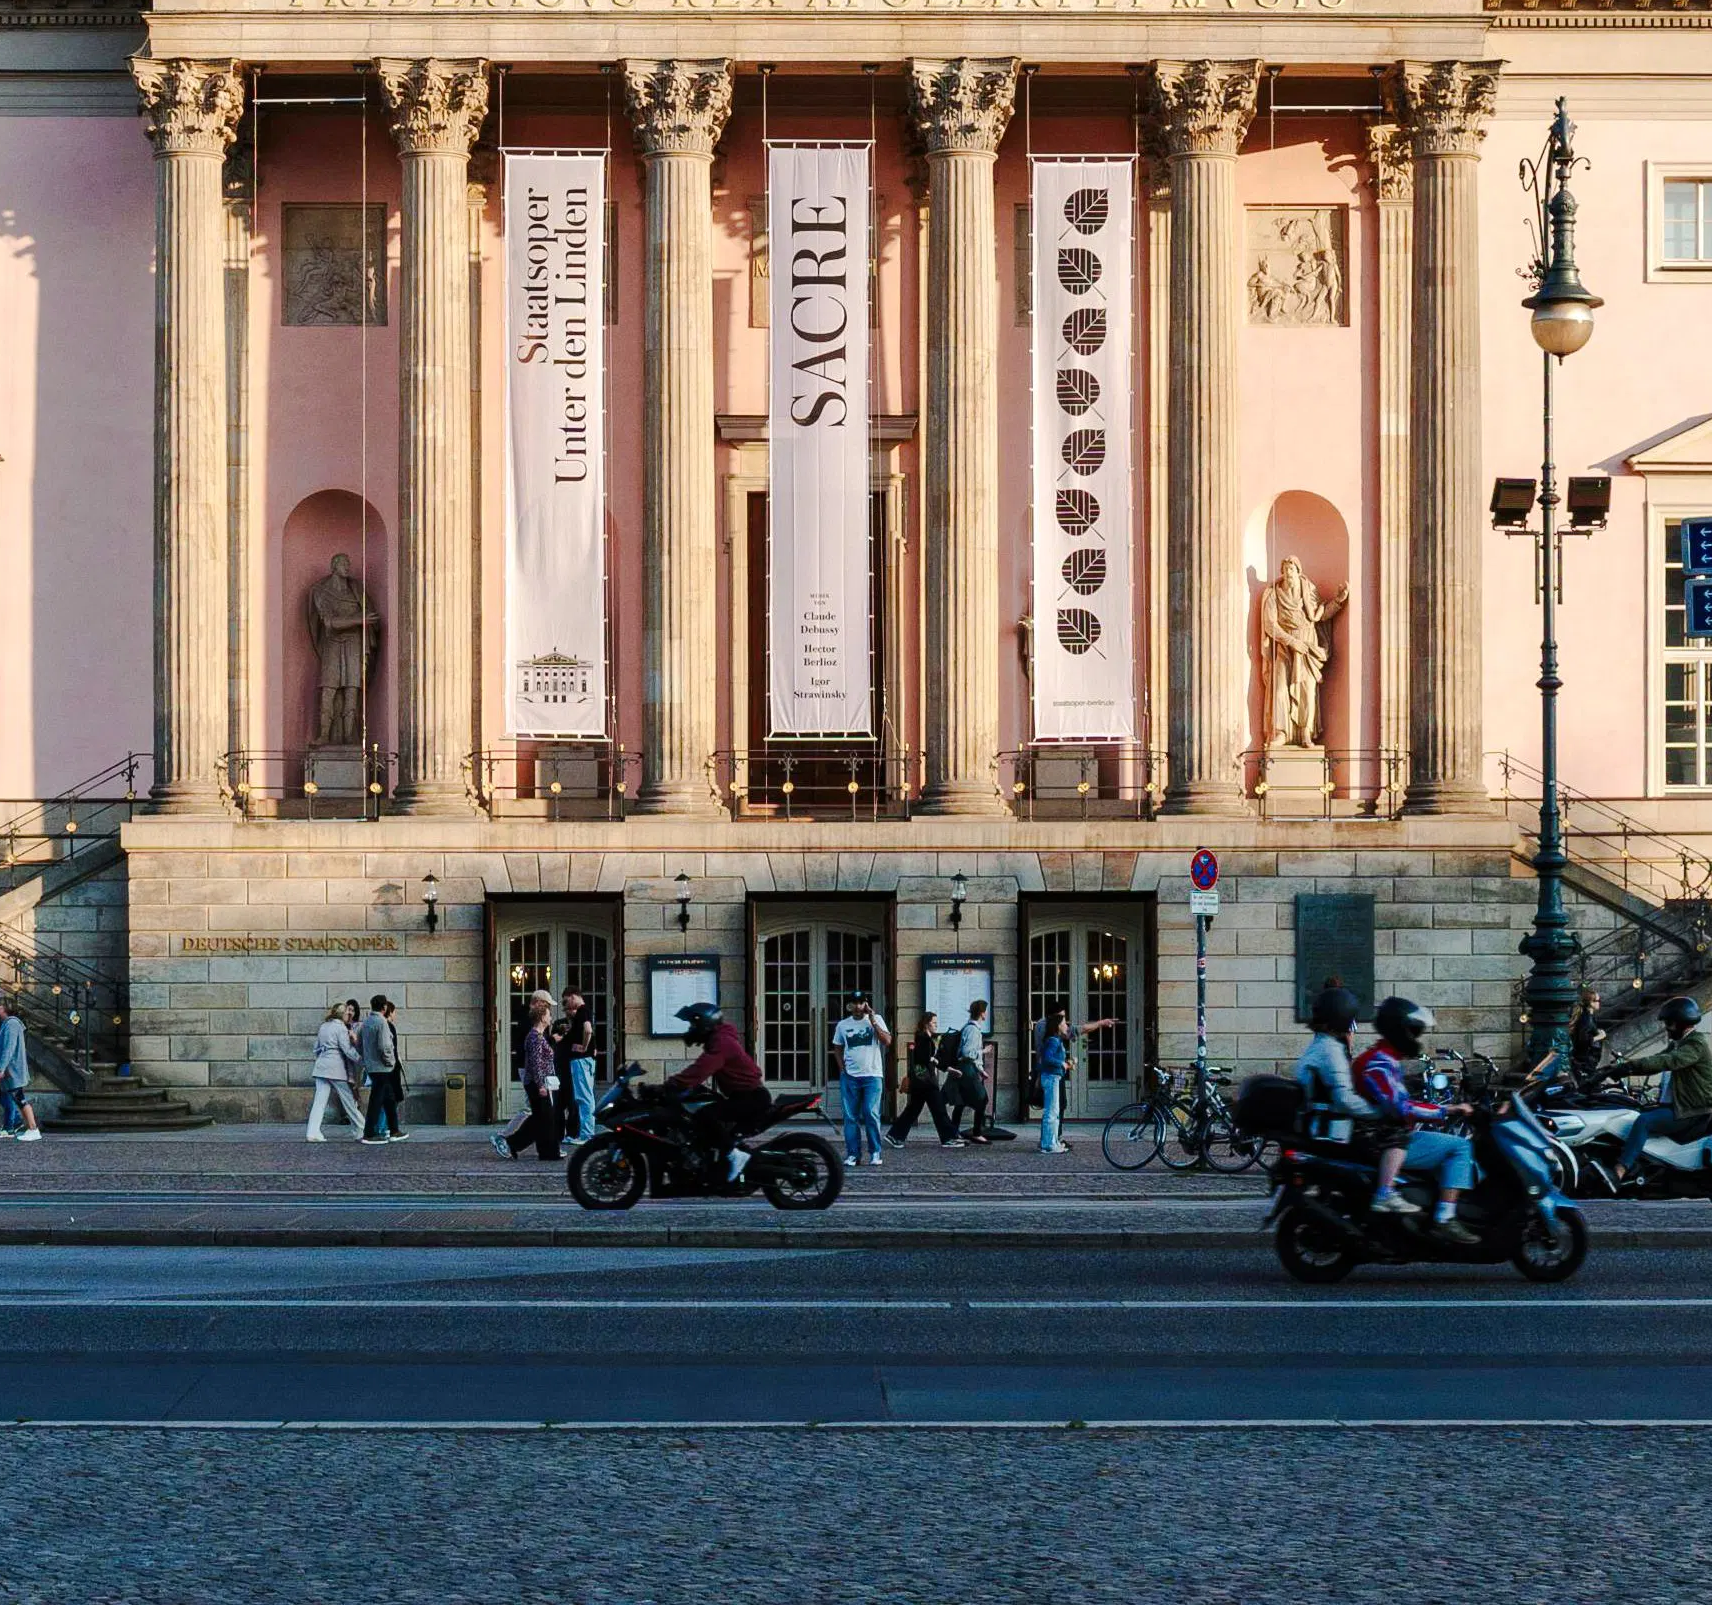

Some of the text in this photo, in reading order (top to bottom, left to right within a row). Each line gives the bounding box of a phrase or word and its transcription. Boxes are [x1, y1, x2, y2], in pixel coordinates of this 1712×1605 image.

[517, 188, 558, 364] Staatsoper
[790, 196, 847, 428] SACRE
[554, 187, 587, 485] Unter den Linden
[804, 612, 836, 621] Claude
[800, 625, 839, 636] Debussy
[804, 644, 837, 653] Hector
[803, 657, 838, 667] Berlioz
[811, 677, 831, 686] Igor
[793, 691, 847, 701] Strawinsky
[182, 936, 399, 952] DEUTSCHE STAATSOPER
